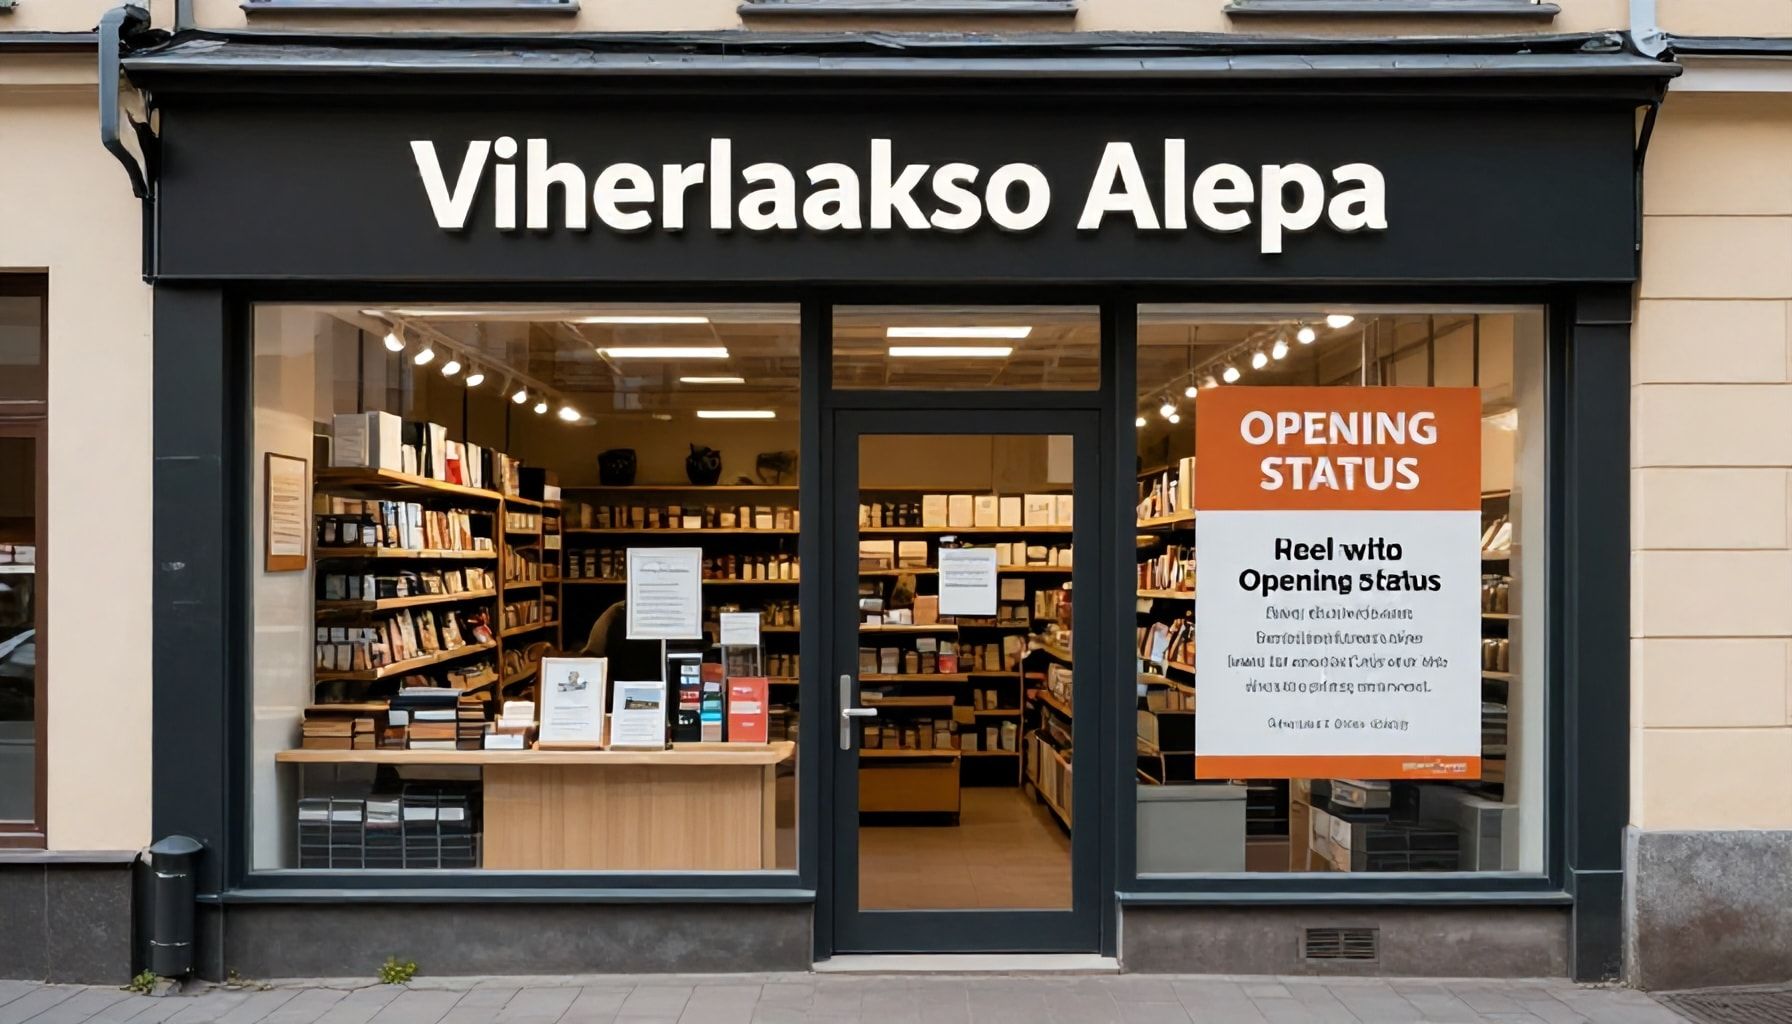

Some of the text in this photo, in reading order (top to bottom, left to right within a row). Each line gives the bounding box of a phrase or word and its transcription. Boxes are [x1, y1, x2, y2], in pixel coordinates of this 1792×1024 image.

[410, 136, 1388, 254] Viherlaakso Alepa
[1240, 410, 1438, 445] OPENING
[1260, 456, 1420, 491] STATUS
[1274, 537, 1334, 561] Reel
[1238, 568, 1353, 598] Opening
